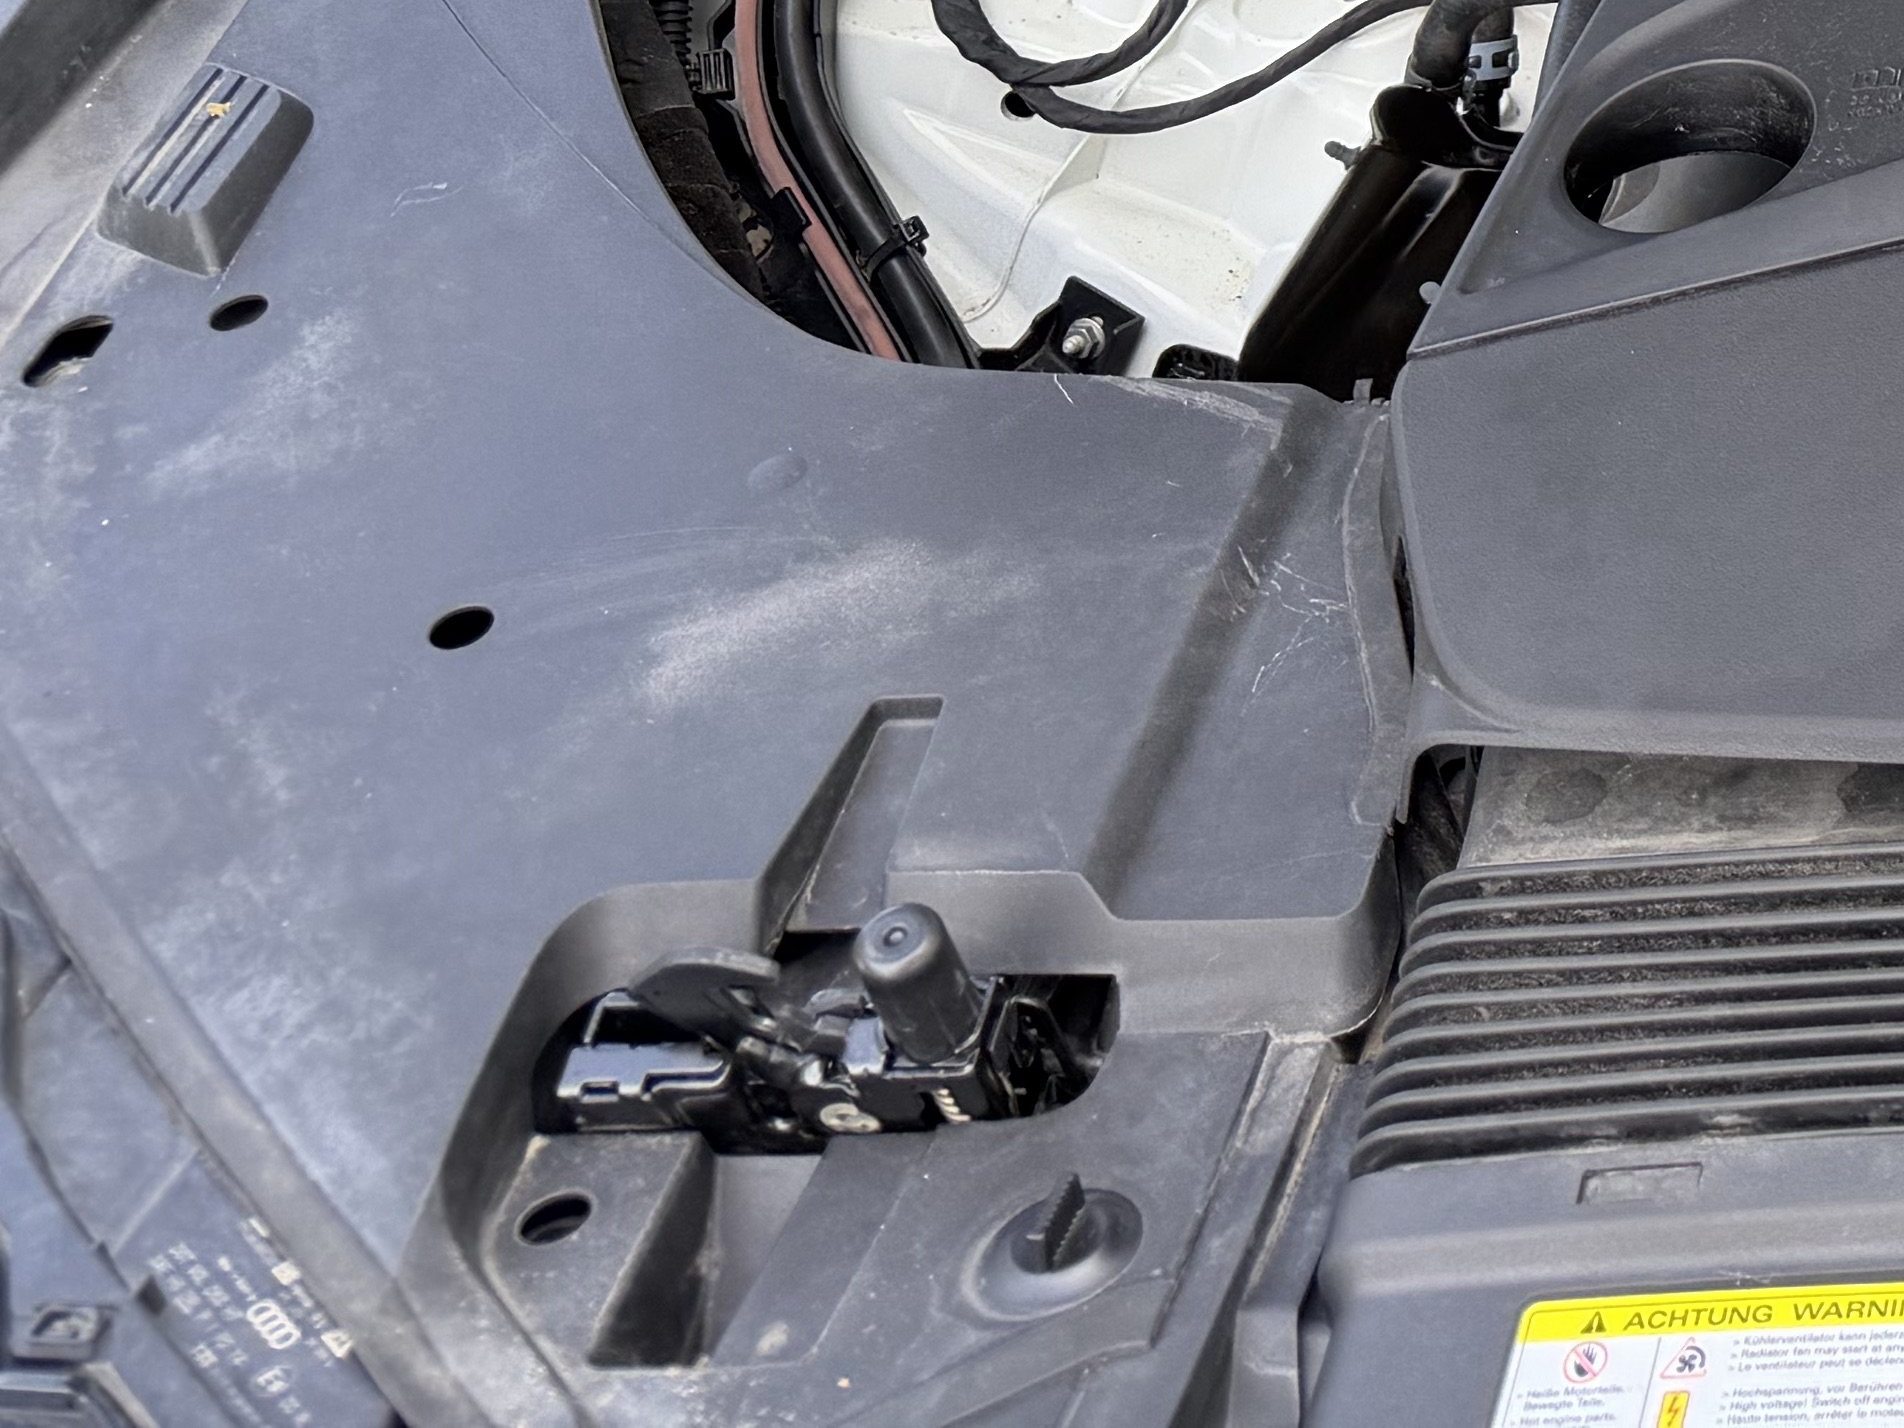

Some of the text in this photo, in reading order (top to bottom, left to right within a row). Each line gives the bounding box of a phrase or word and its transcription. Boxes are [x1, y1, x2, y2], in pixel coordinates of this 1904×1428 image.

[1623, 1304, 1773, 1331] ACHTUNG
[1741, 1349, 1789, 1358] Radiator
[1793, 1347, 1810, 1356] fan
[1814, 1347, 1839, 1356] may
[1730, 1401, 1757, 1412] High
